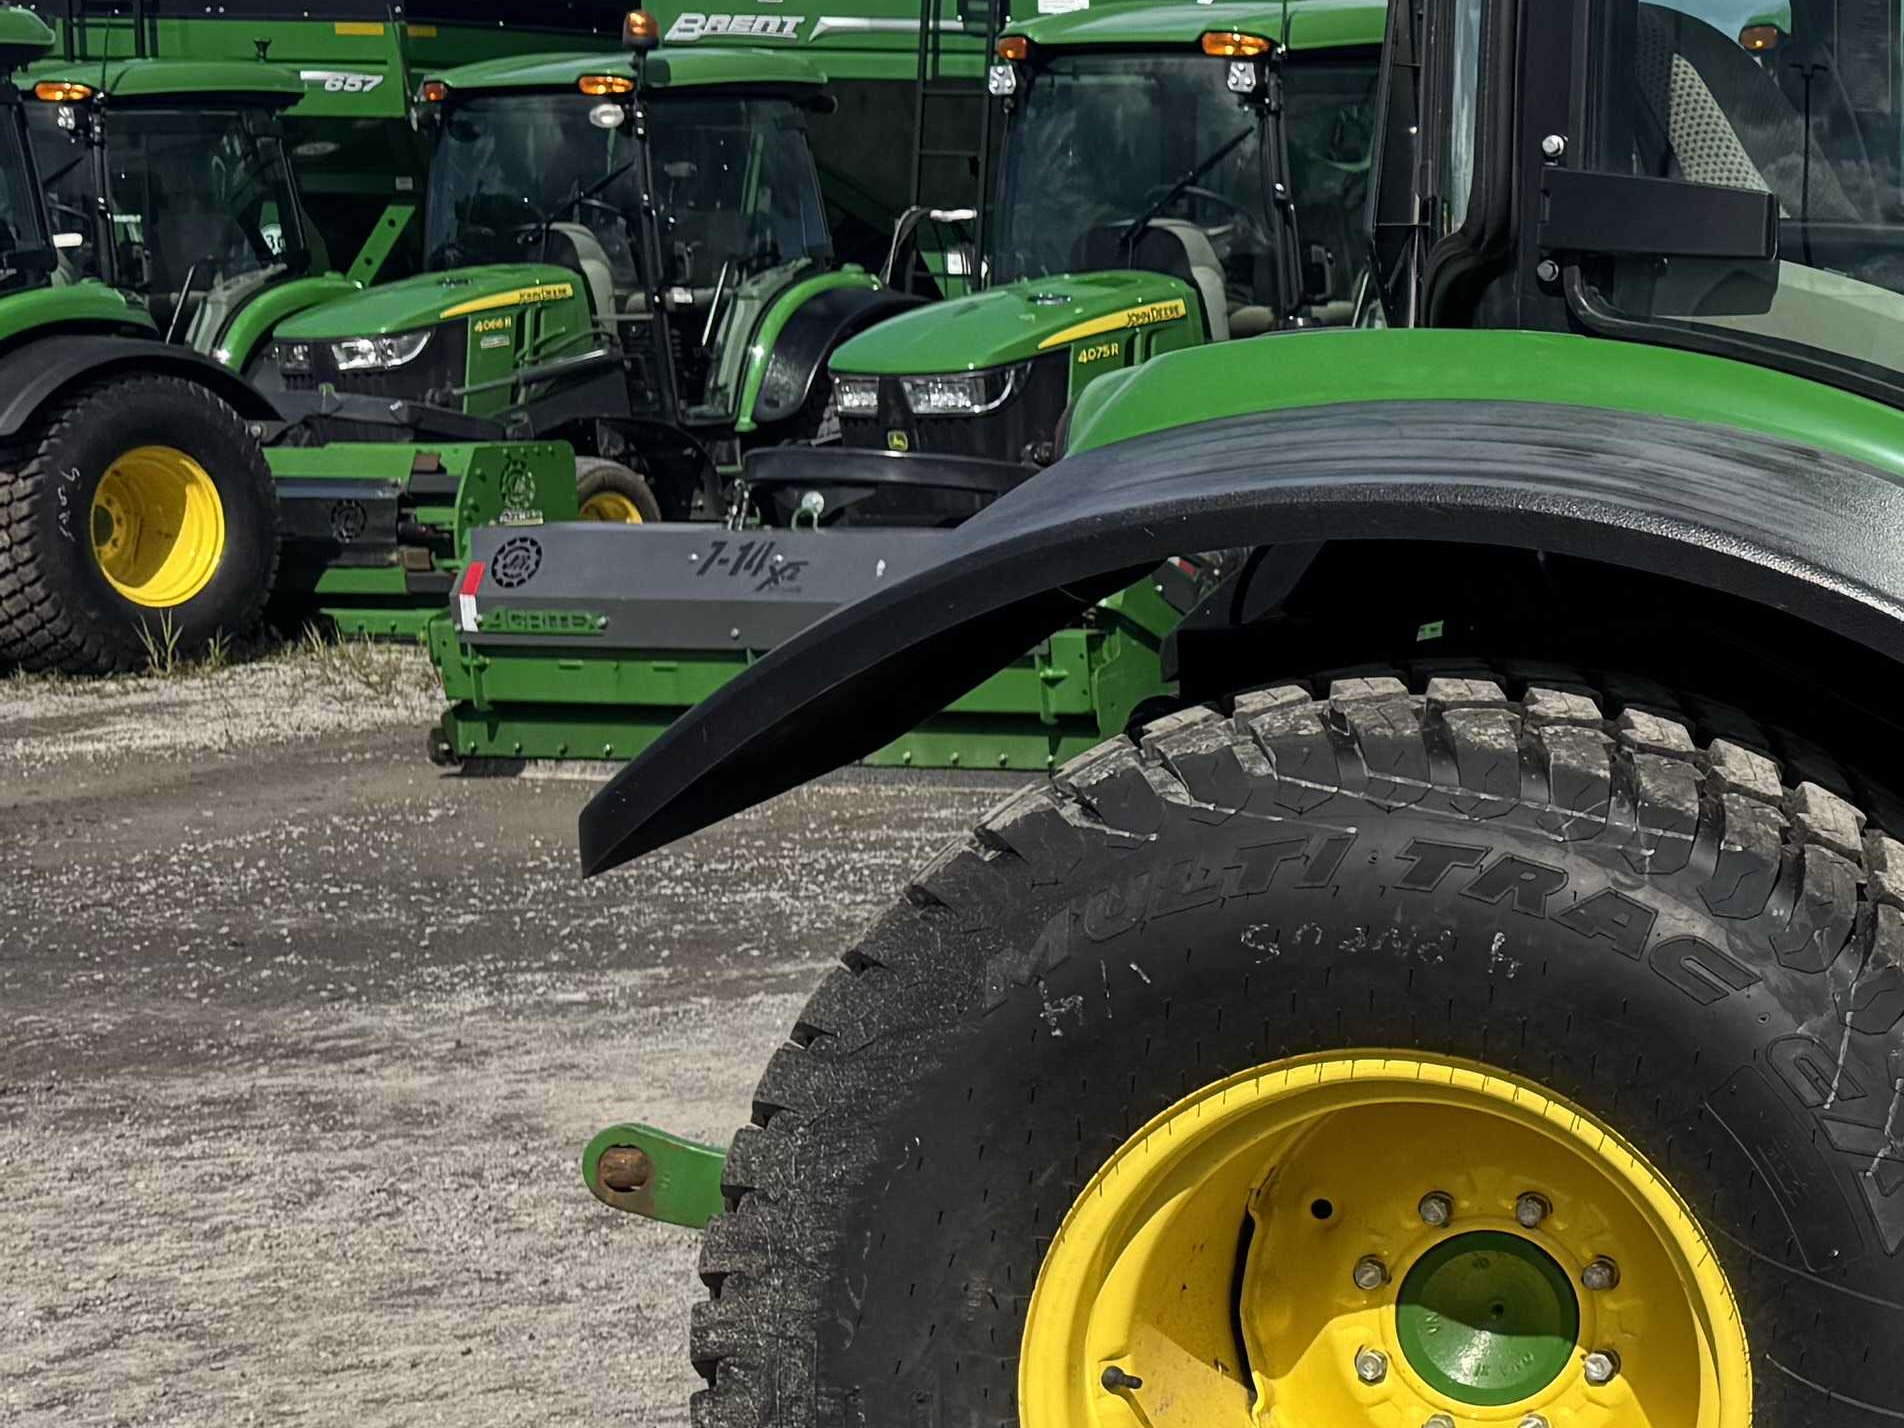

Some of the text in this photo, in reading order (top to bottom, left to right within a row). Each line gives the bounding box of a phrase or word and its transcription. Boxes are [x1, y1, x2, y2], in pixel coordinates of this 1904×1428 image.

[664, 12, 806, 42] BRENT
[324, 74, 384, 92] 657
[1393, 837, 1764, 1007] TRAC
